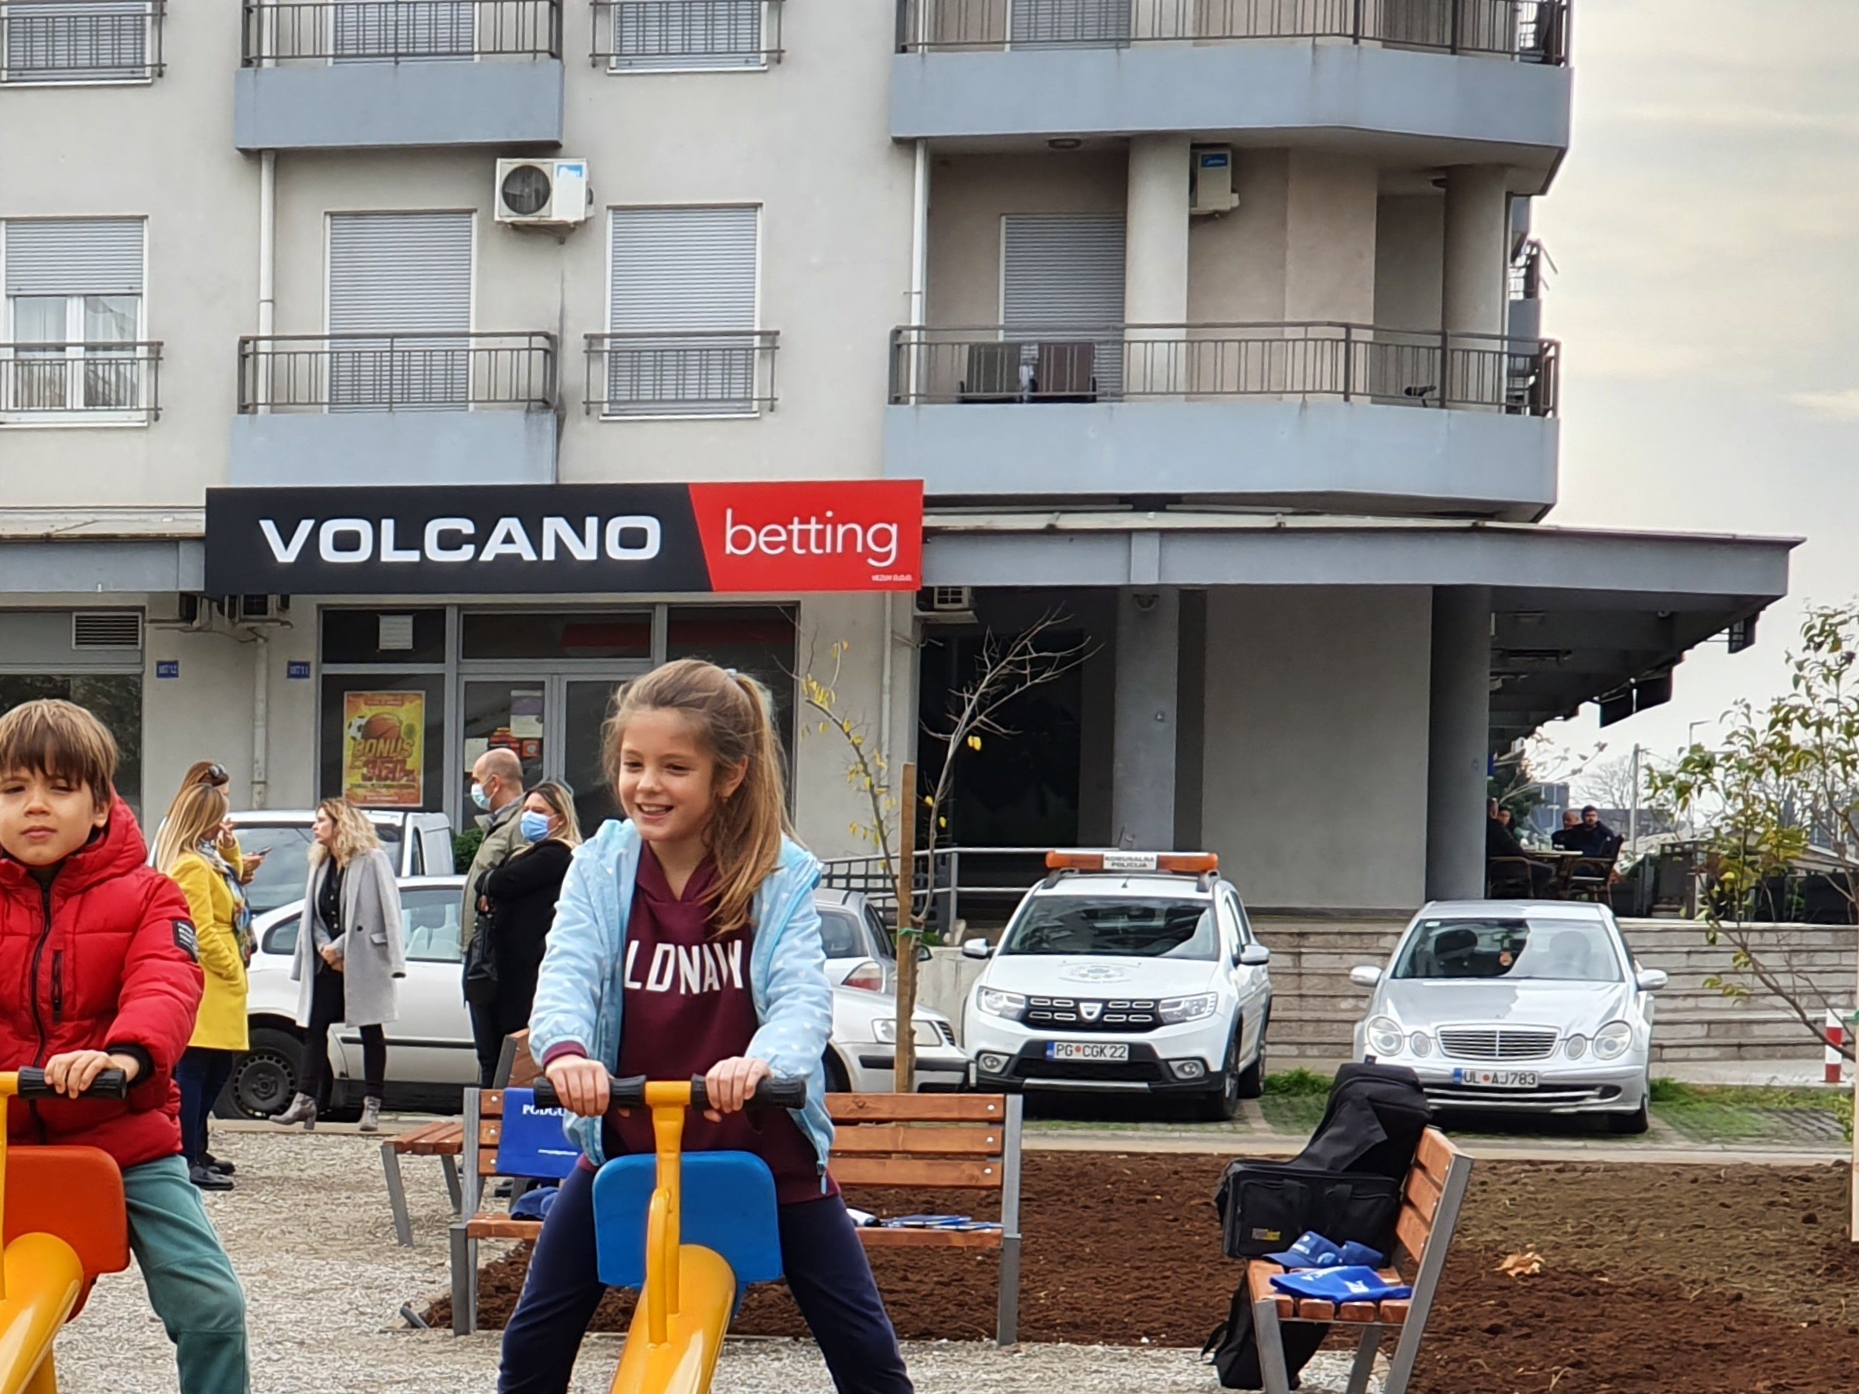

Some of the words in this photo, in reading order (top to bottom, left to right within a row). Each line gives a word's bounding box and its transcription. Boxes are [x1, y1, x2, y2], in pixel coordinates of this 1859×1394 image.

[258, 515, 661, 563] VOLCANO
[725, 507, 898, 567] betting
[352, 738, 416, 759] BONUS
[1056, 1044, 1073, 1057] PG
